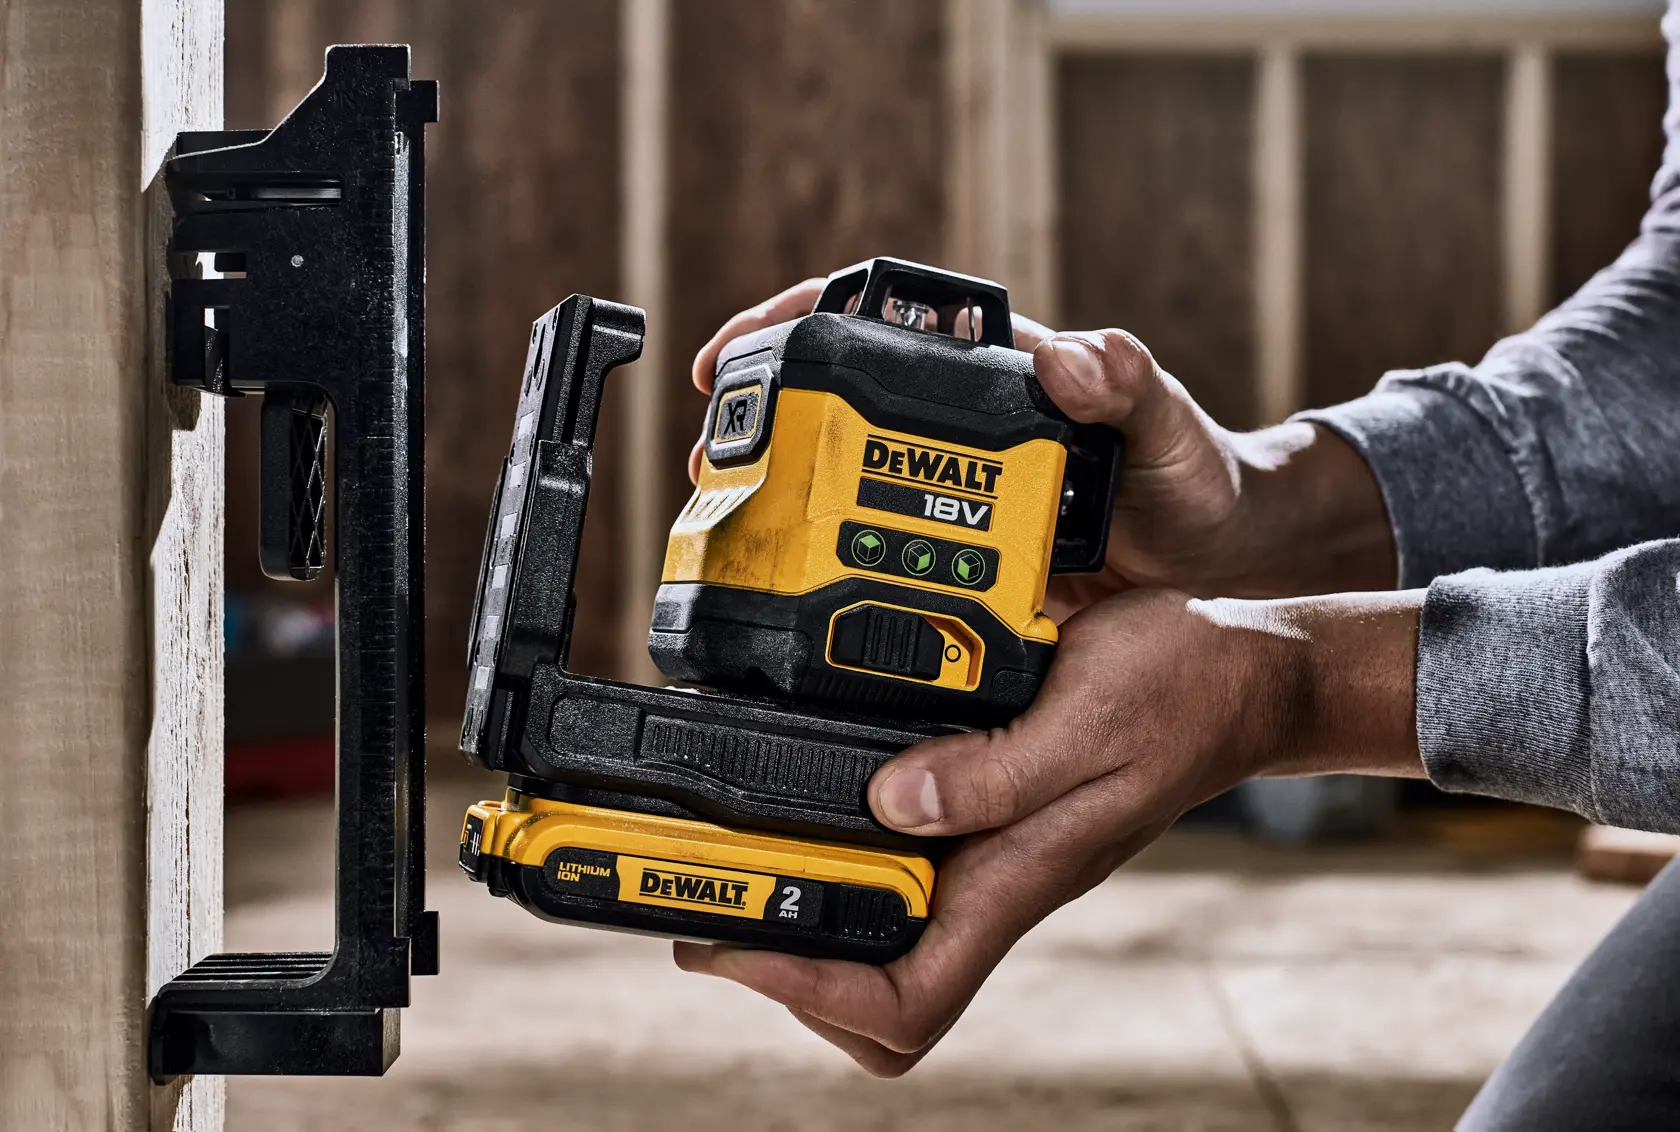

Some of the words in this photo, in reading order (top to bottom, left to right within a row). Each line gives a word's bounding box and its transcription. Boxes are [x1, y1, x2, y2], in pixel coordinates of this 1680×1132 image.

[923, 494, 990, 526] 18V
[557, 870, 580, 883] ION
[559, 861, 611, 878] LITHIUM
[779, 886, 802, 912] 2
[778, 910, 798, 919] AH
